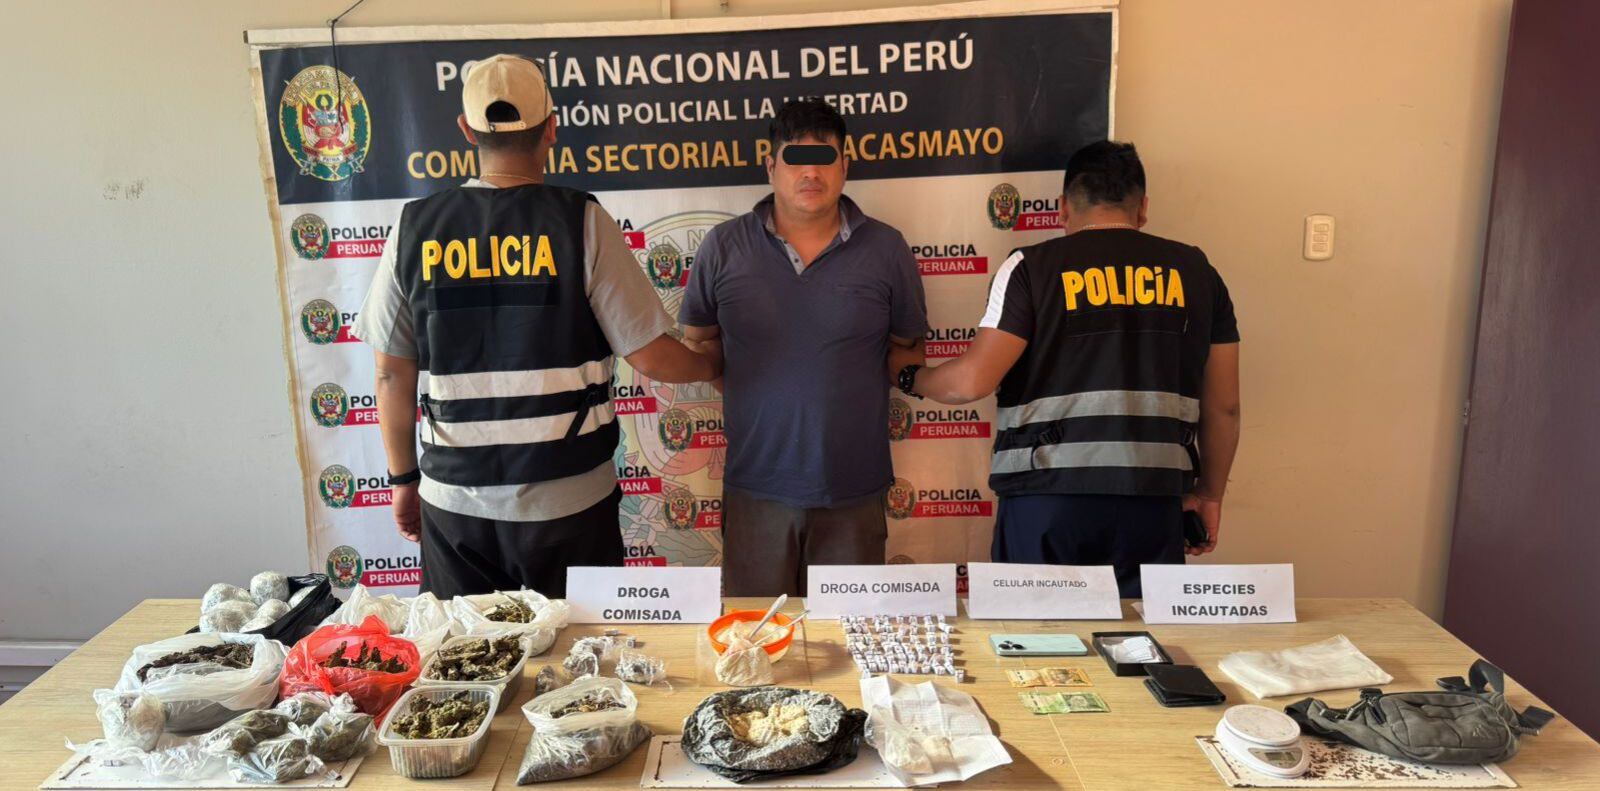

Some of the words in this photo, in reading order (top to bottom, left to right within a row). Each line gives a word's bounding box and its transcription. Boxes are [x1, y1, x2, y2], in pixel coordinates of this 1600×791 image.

[596, 49, 790, 87] NACIONAL
[800, 45, 869, 79] DEL
[879, 32, 975, 74] PERÚ
[617, 99, 737, 125] POLICIAL
[744, 97, 776, 120] LA
[585, 139, 748, 173] SECTORIAL
[842, 126, 1005, 162] ACASMAYO
[1022, 198, 1059, 212] POLI
[1025, 215, 1059, 227] PERU
[925, 327, 977, 341] OLICIA
[915, 409, 980, 422] POLICIA
[920, 425, 978, 436] PERUANA
[918, 488, 982, 501] POLICIA
[922, 503, 980, 515] PERUANA
[820, 582, 870, 595] DROGA
[871, 581, 941, 594] COMISADA
[993, 579, 1034, 588] CELULAR
[1036, 580, 1088, 589] INCAUTADO
[1183, 583, 1256, 596] ESPECIES
[617, 586, 670, 599] DROGA
[602, 608, 682, 622] COMISADA
[1171, 604, 1268, 617] INCAUTADAS
